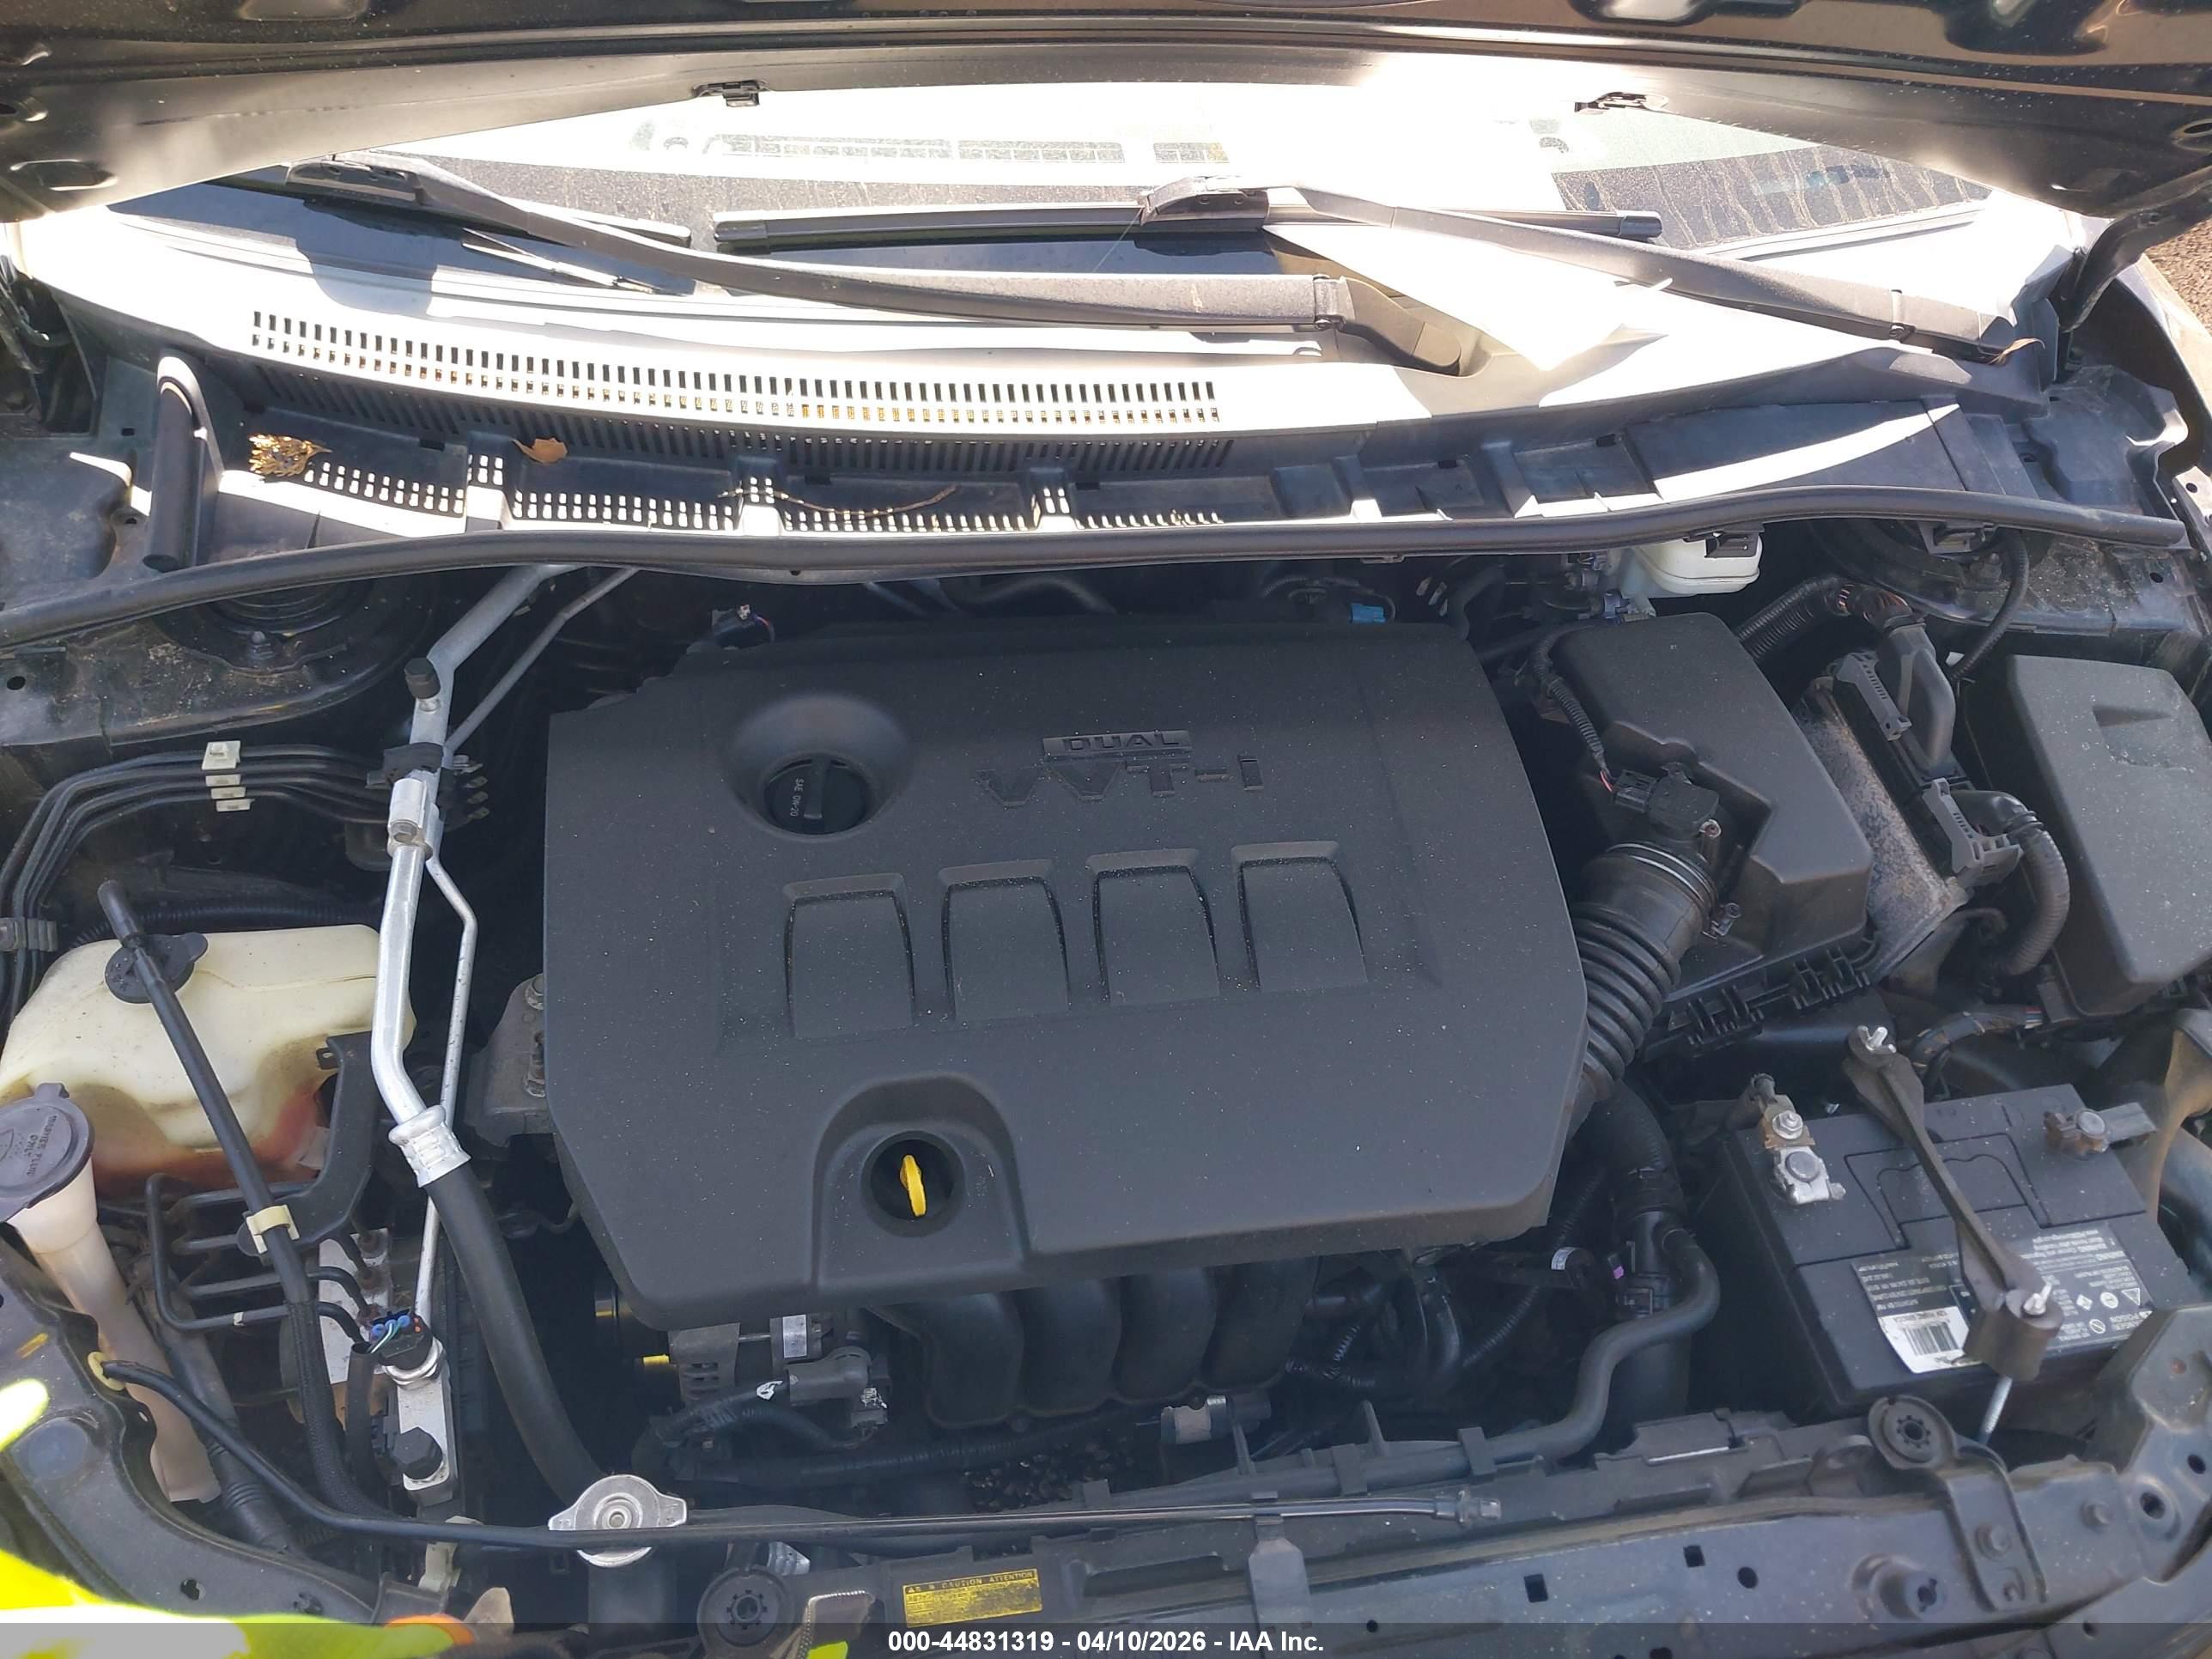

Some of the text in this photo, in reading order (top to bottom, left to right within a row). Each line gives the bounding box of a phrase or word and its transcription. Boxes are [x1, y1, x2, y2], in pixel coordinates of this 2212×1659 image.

[1061, 732, 1180, 751] DUAL
[794, 778, 805, 793] SAE
[941, 1571, 1033, 1589] CAUTION ATTENTION
